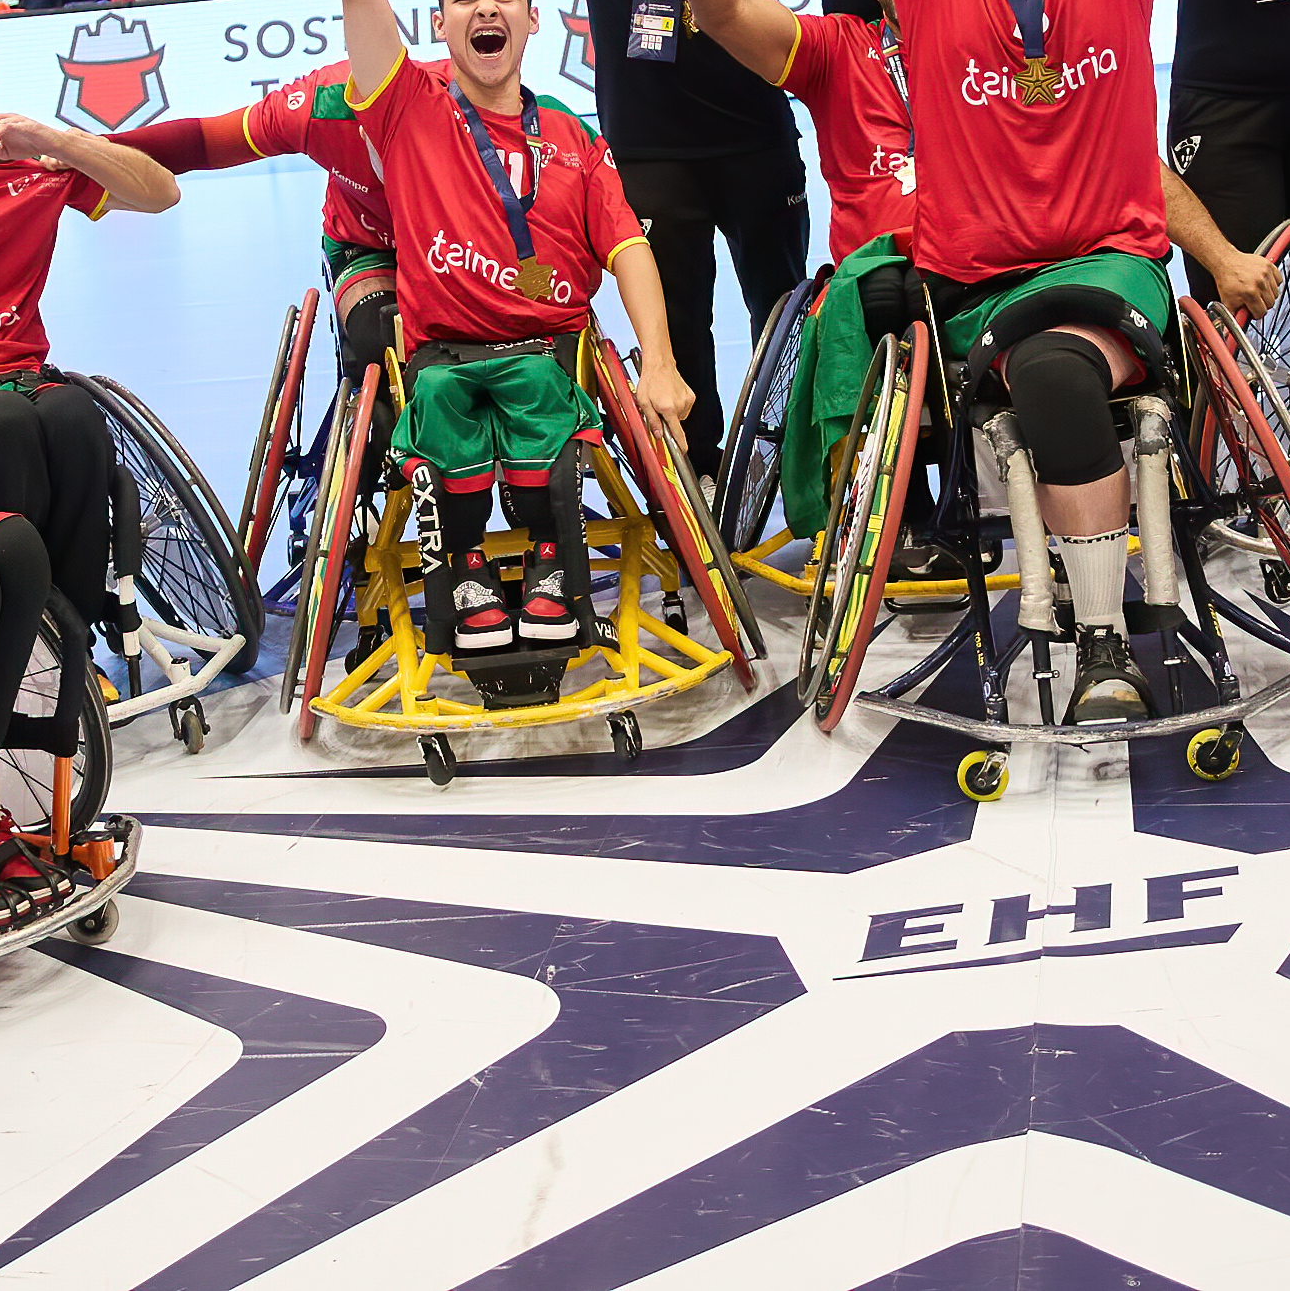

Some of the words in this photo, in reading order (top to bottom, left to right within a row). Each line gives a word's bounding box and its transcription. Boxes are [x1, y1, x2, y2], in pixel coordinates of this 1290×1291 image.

[331, 166, 369, 194] Kempa
[359, 290, 386, 305] ALLSIX
[411, 465, 443, 576] EXTRA
[857, 866, 1240, 962] EHF
